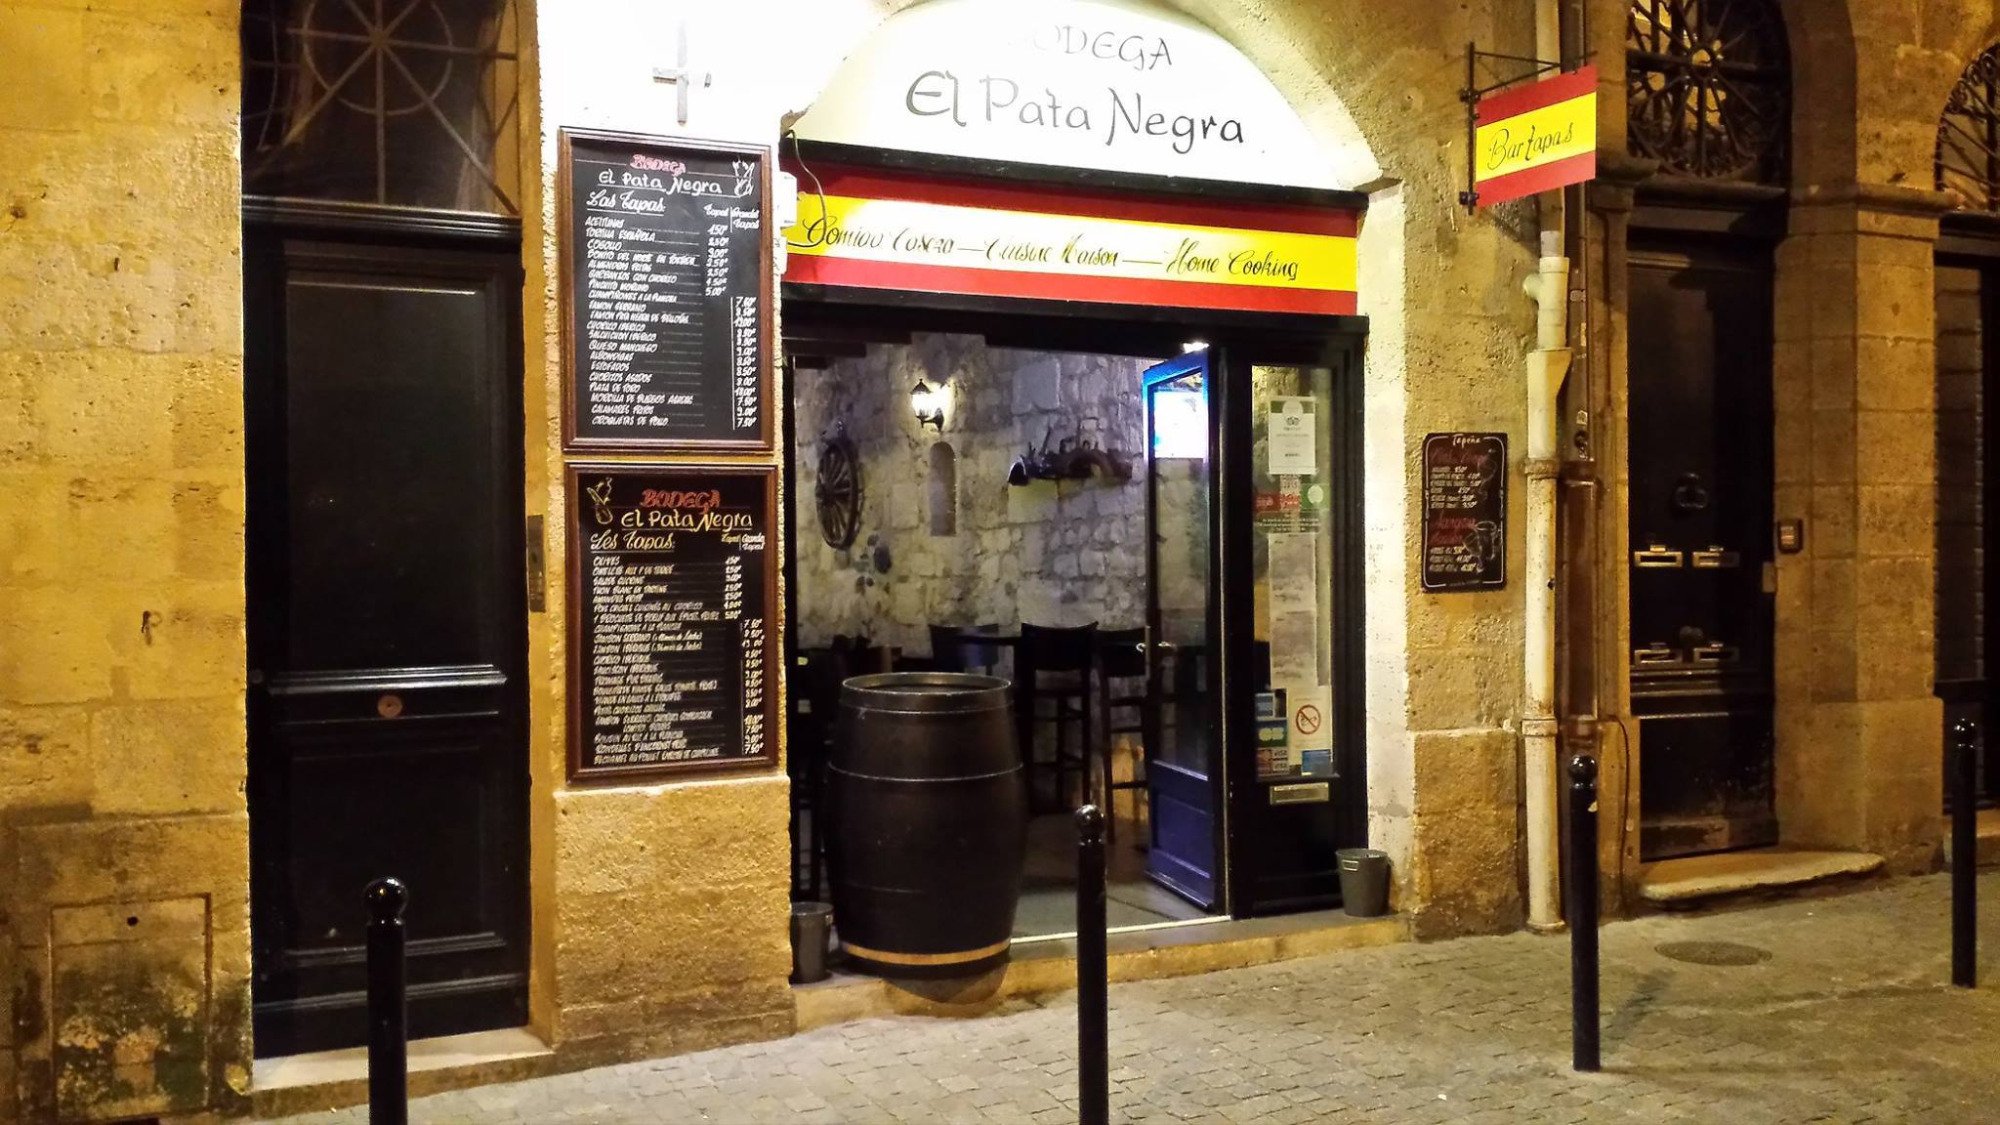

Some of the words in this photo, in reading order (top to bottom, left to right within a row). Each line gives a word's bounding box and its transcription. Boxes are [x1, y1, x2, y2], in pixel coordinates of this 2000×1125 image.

[906, 71, 967, 127] El
[980, 75, 1091, 130] Pata
[1106, 87, 1243, 154] Negra
[1487, 128, 1522, 171] Bar
[1524, 121, 1574, 161] tapas
[598, 168, 615, 184] El
[622, 172, 662, 188] Pata
[666, 177, 722, 196] Negra
[586, 190, 616, 207] Las
[1165, 237, 1220, 274] Home
[1228, 249, 1298, 281] Cooking
[640, 489, 720, 514] BODEGA
[621, 509, 644, 528] El
[648, 508, 693, 528] Pata
[690, 512, 753, 533] Negra
[590, 529, 618, 550] Les
[593, 555, 620, 567] OLIVES
